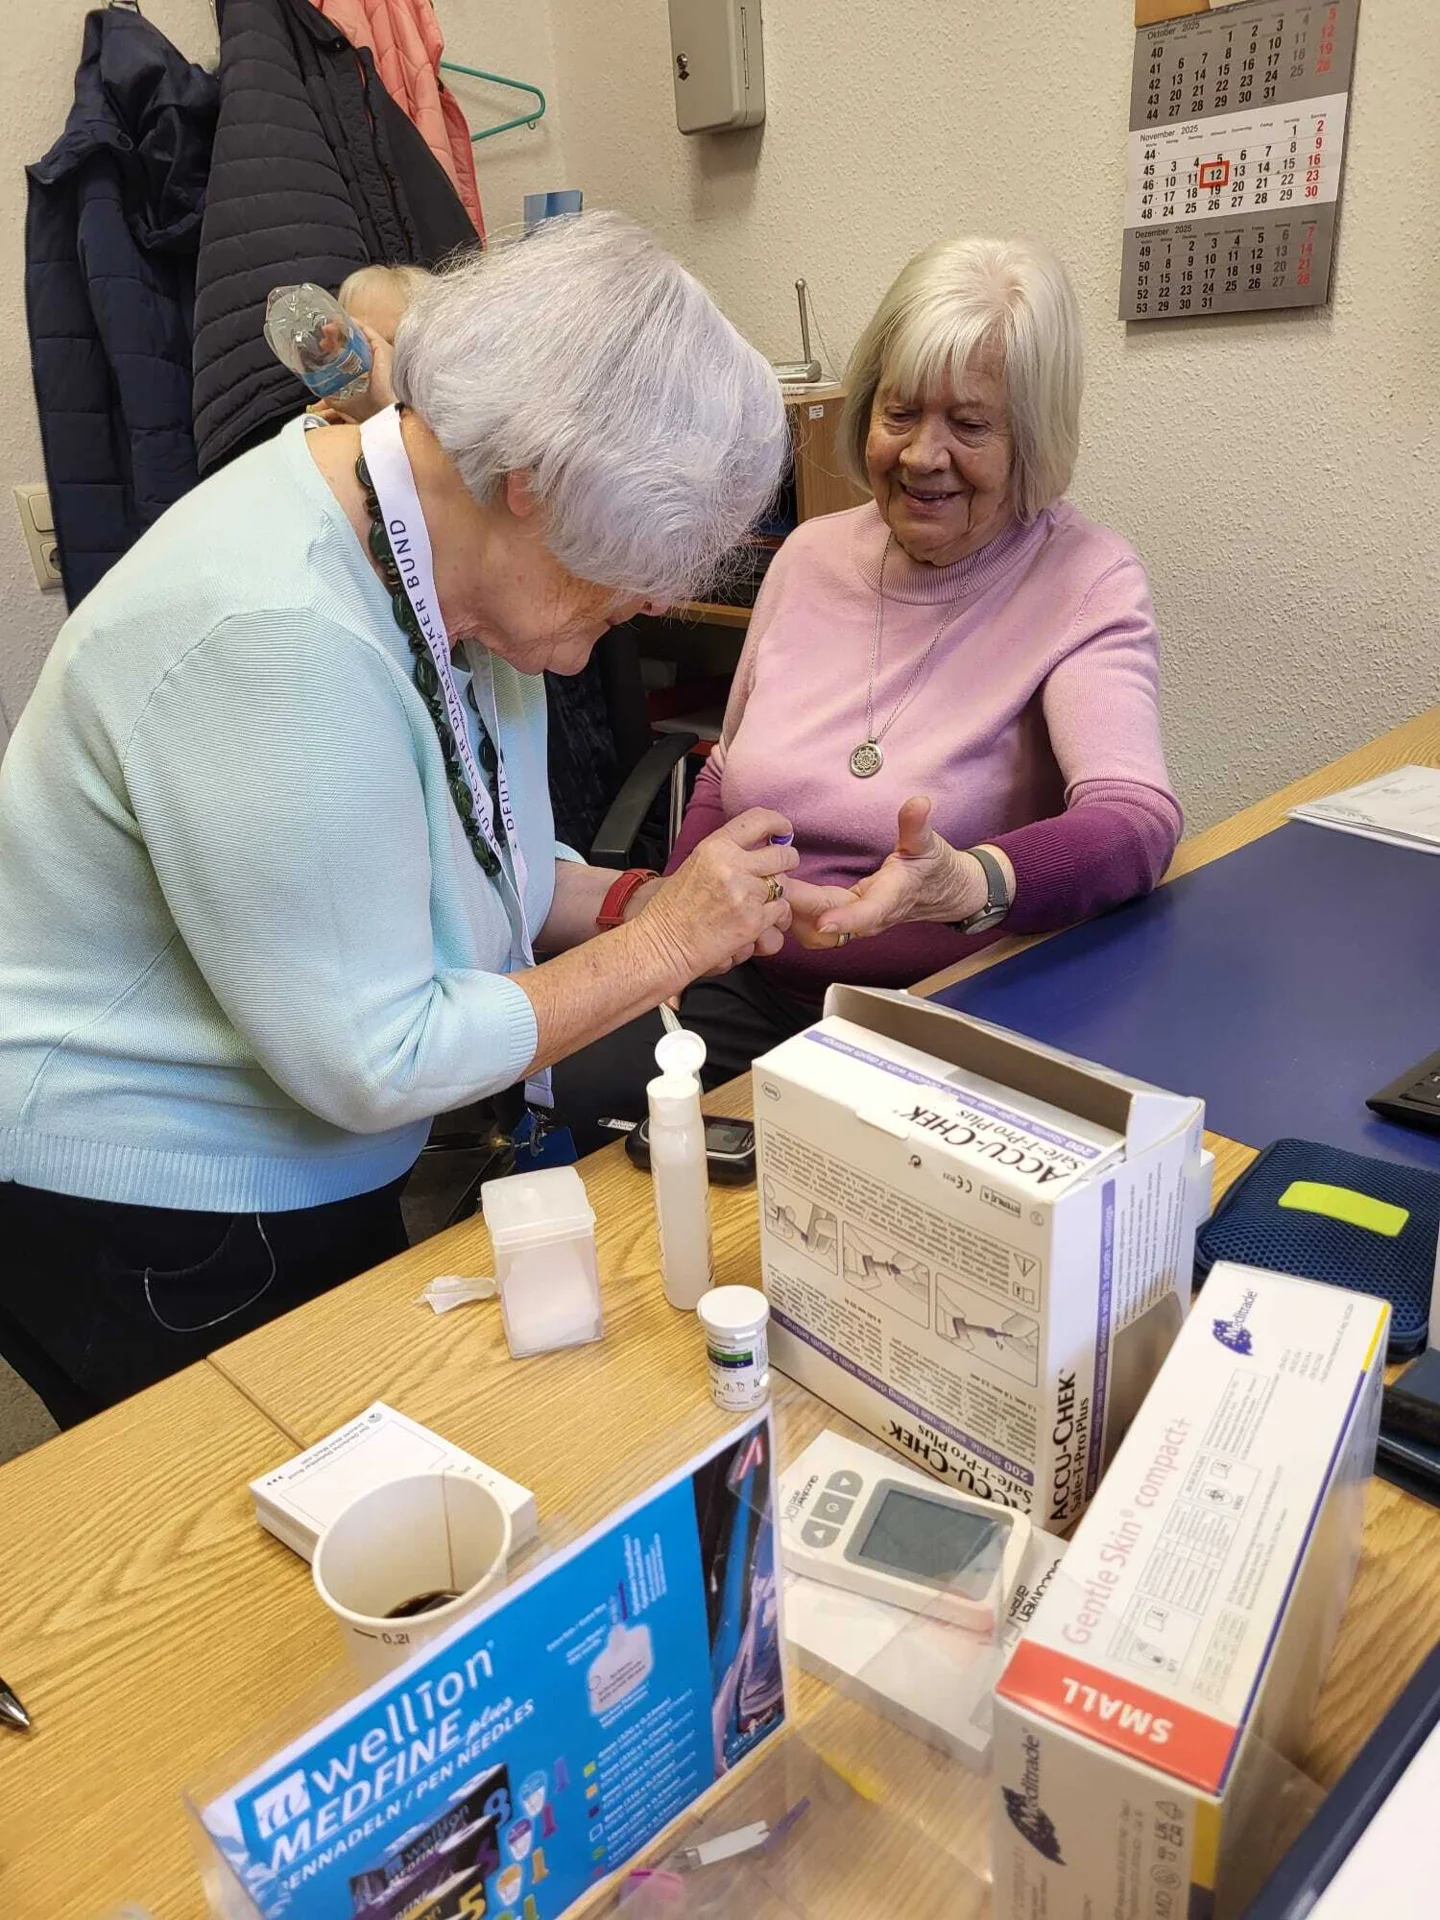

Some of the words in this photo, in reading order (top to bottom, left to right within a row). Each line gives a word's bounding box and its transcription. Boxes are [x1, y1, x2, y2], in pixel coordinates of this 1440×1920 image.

[1148, 28, 1176, 40] Oktober
[1183, 22, 1199, 32] 2025
[1151, 47, 1163, 58] 40
[1228, 32, 1232, 42] 1
[1252, 26, 1258, 37] 2
[1277, 21, 1283, 31] 3
[1149, 79, 1160, 90] 42
[1172, 74, 1183, 85] 13
[1194, 69, 1206, 81] 14
[1218, 64, 1230, 75] 15
[1243, 59, 1254, 70] 16
[1267, 54, 1279, 65] 17
[1150, 63, 1161, 75] 41
[1178, 58, 1184, 68] 6
[1202, 53, 1208, 63] 7
[1225, 48, 1231, 59] 8
[1250, 43, 1256, 53] 9
[1269, 39, 1281, 49] 10
[1295, 33, 1306, 43] 11
[1147, 110, 1158, 120] 44
[1169, 105, 1180, 116] 27
[1191, 100, 1203, 112] 28
[1214, 95, 1227, 107] 29
[1239, 91, 1251, 103] 30
[1263, 86, 1276, 98] 31
[1148, 94, 1159, 105] 43
[1170, 90, 1182, 101] 20
[1192, 85, 1204, 96] 21
[1216, 80, 1228, 91] 22
[1240, 75, 1253, 86] 23
[1264, 70, 1278, 82] 24
[1290, 66, 1303, 77] 25
[1140, 129, 1175, 141] November
[1181, 125, 1198, 135] 2025
[1144, 149, 1156, 160] 44
[1292, 126, 1297, 136] 1
[1317, 120, 1324, 131] 2
[1143, 179, 1154, 190] 46
[1165, 176, 1176, 187] 10
[1188, 173, 1198, 184] 11
[1210, 169, 1222, 179] 12
[1234, 166, 1245, 177] 13
[1258, 162, 1270, 173] 14
[1283, 158, 1295, 169] 15
[1308, 154, 1320, 165] 16
[1144, 165, 1154, 175] 45
[1171, 161, 1177, 172] 3
[1194, 157, 1199, 168] 4
[1217, 154, 1223, 164] 5
[1240, 150, 1246, 161] 6
[1266, 146, 1271, 157] 7
[1290, 142, 1296, 153] 8
[1316, 137, 1322, 149] 9
[1141, 209, 1153, 219] 48
[1163, 206, 1174, 217] 24
[1185, 203, 1197, 213] 25
[1208, 200, 1219, 211] 26
[1231, 196, 1243, 207] 27
[1255, 193, 1267, 204] 28
[1280, 189, 1292, 201] 29
[1305, 186, 1318, 197] 30
[1142, 194, 1153, 204] 47
[1164, 191, 1175, 202] 17
[1186, 188, 1198, 199] 18
[1209, 185, 1221, 196] 19
[1232, 182, 1244, 192] 20
[1256, 177, 1268, 189] 21
[1281, 174, 1294, 185] 22
[1306, 170, 1319, 182] 23
[1135, 228, 1169, 238] Dezember
[1175, 225, 1192, 233] 2025
[1139, 246, 1151, 257] 49
[1167, 244, 1171, 254] 1
[1189, 241, 1195, 251] 2
[1212, 238, 1217, 249] 3
[1234, 236, 1240, 246] 4
[1258, 232, 1264, 243] 5
[1282, 229, 1288, 240] 6
[1138, 261, 1150, 272] 50
[1165, 258, 1171, 269] 8
[1188, 256, 1193, 266] 9
[1205, 253, 1216, 264] 10
[1228, 251, 1239, 261] 11
[1251, 248, 1263, 259] 12
[1276, 245, 1288, 256] 13
[1138, 275, 1149, 286] 51
[1160, 273, 1171, 284] 15
[1181, 271, 1192, 281] 16
[1204, 268, 1215, 279] 17
[1227, 266, 1238, 277] 18
[1250, 263, 1262, 274] 19
[1273, 260, 1286, 272] 20
[1136, 303, 1148, 313] 53
[1158, 301, 1169, 312] 29
[1179, 299, 1191, 310] 30
[1201, 297, 1213, 308] 31
[1137, 290, 1148, 300] 52
[1159, 287, 1170, 298] 22
[1180, 285, 1192, 296] 23
[1202, 283, 1214, 294] 24
[1225, 280, 1237, 291] 25
[1248, 278, 1261, 289] 26
[1272, 276, 1285, 287] 27
[389, 518, 418, 590] BUND
[415, 598, 461, 732] DIABETIKER
[1076, 1397, 1089, 1432] Plus
[918, 1424, 949, 1450] Plus
[1050, 1372, 1076, 1520] ACCU-CHEK
[950, 1448, 1033, 1503] Safe-T-Pro
[1004, 1459, 1028, 1480] 200
[1070, 1432, 1086, 1513] Safe-T-Pro
[1062, 1570, 1119, 1646] Gentle
[1135, 1417, 1191, 1510] compact+
[1061, 1675, 1174, 1745] SMALL
[416, 1763, 454, 1800] PEN
[457, 1698, 535, 1771] NEEDLES
[271, 1708, 464, 1870] MEDFINE
[463, 1696, 514, 1742] plus
[1021, 1734, 1041, 1830] Meditrade
[483, 1786, 512, 1826] 8
